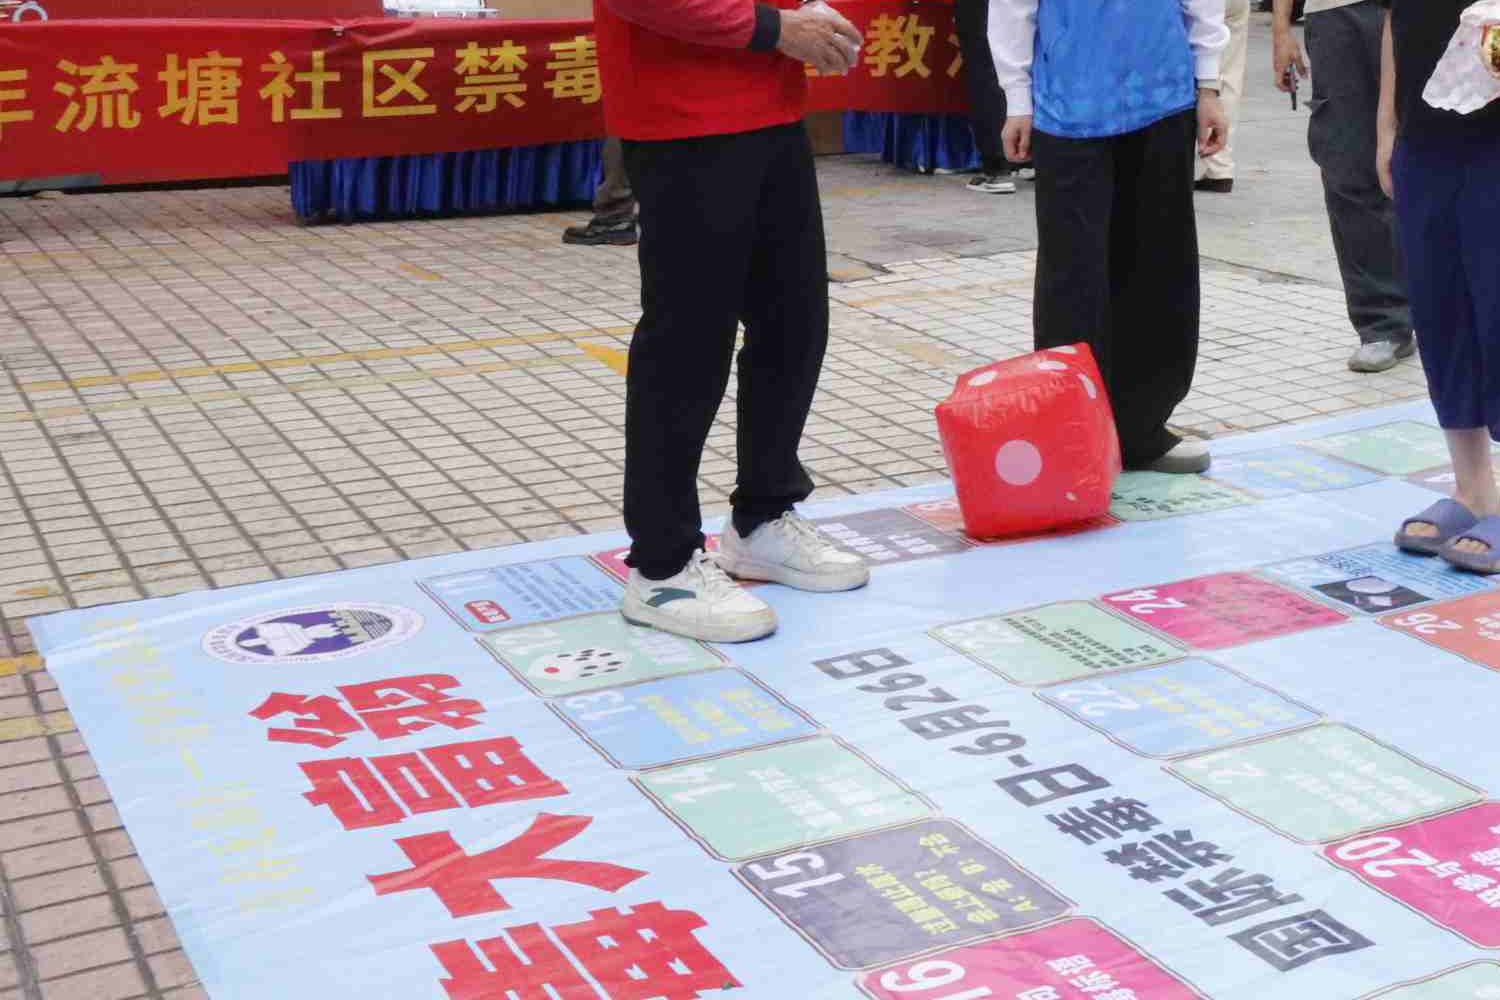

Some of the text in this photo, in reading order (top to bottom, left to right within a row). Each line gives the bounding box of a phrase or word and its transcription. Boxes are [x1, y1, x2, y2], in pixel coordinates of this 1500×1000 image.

[1107, 587, 1188, 615] 24
[1390, 611, 1458, 636] 26
[560, 689, 630, 724] 13
[655, 763, 738, 805] 14
[812, 646, 1377, 973] 国际禁毒日-6月26日
[746, 850, 847, 901] 15
[1332, 834, 1424, 881] 20
